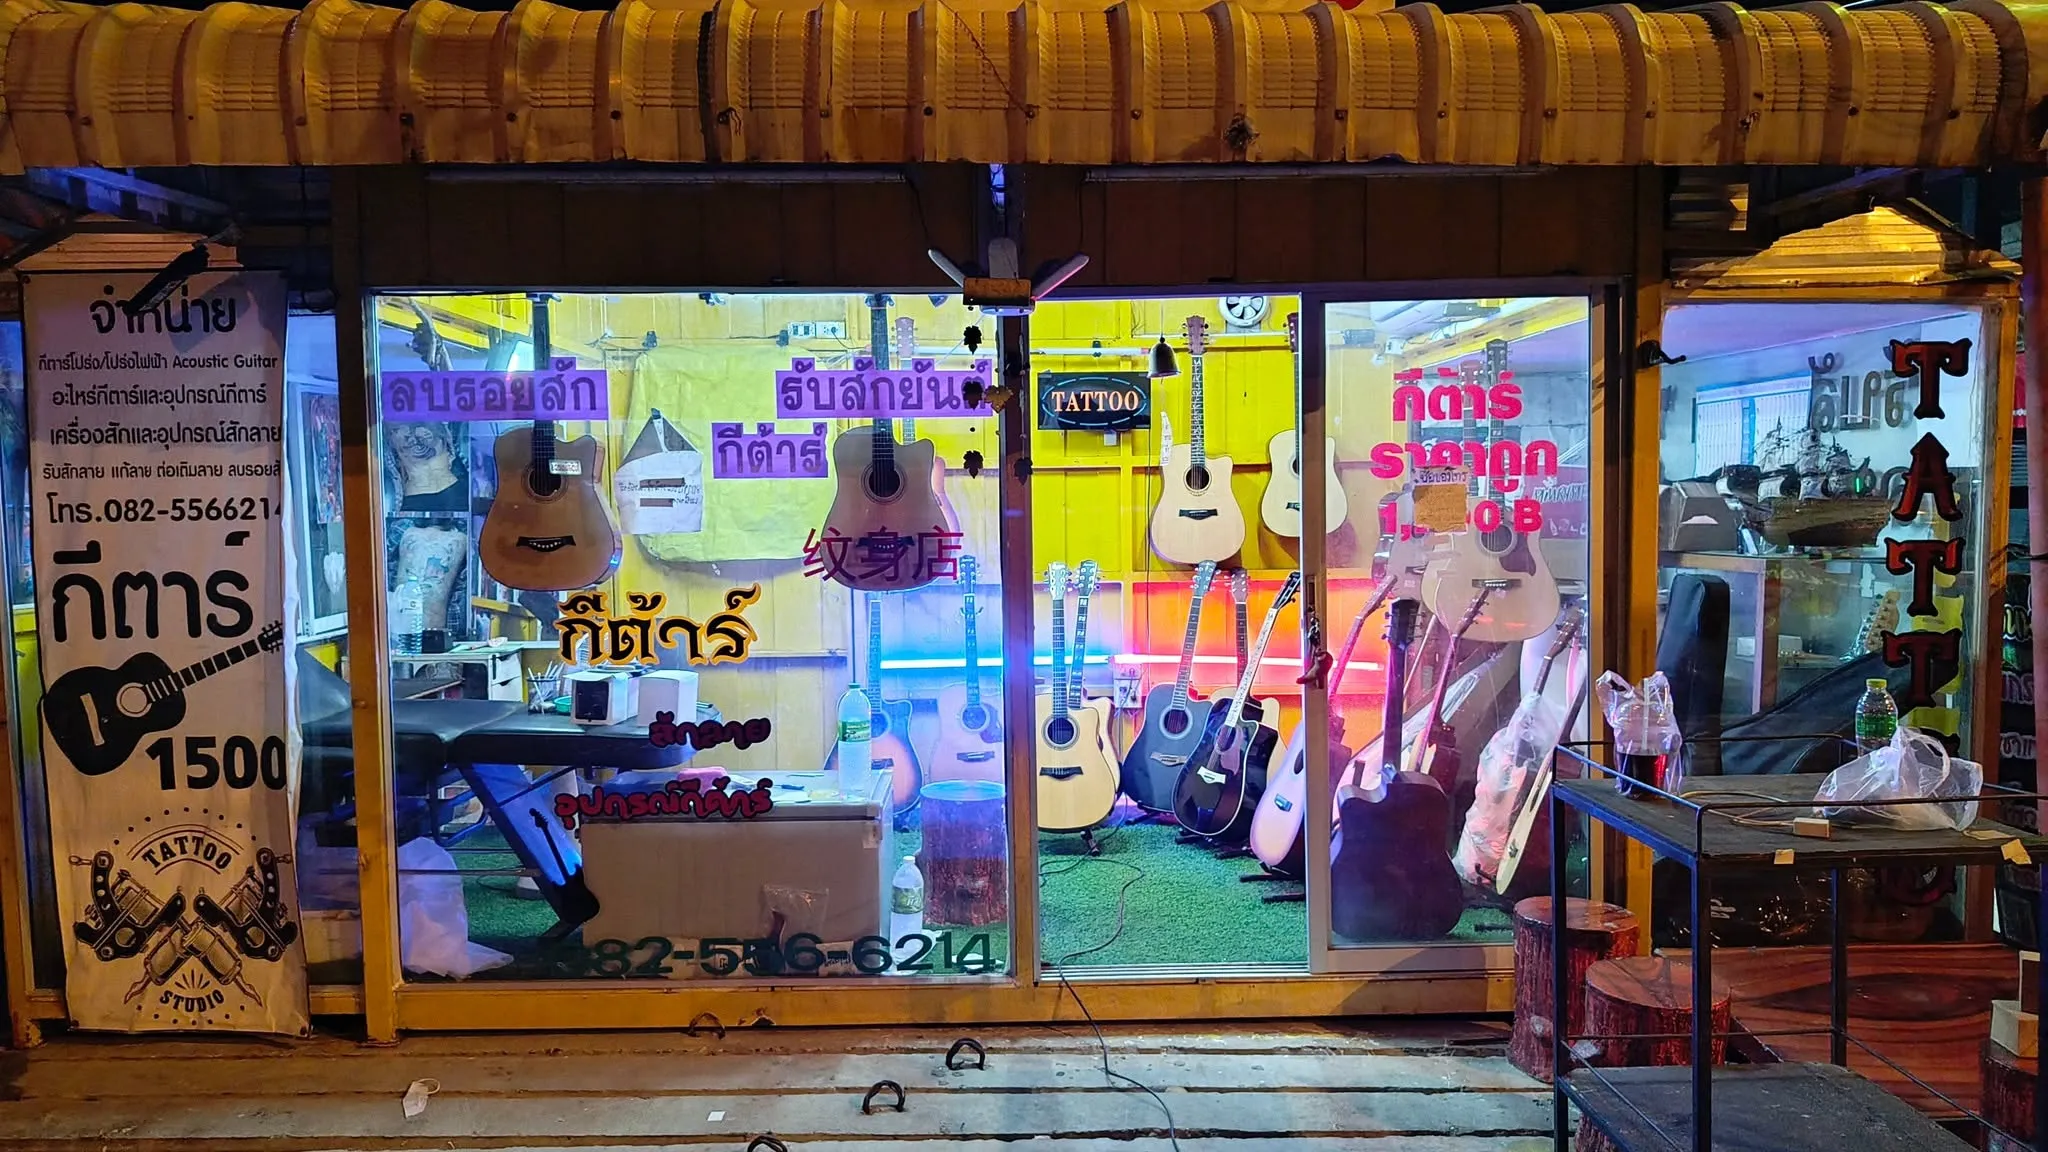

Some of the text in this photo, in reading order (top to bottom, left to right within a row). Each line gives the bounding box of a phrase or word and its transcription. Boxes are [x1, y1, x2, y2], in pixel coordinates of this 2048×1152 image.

[173, 354, 229, 369] Acoustic
[234, 353, 279, 369] Guitar
[389, 358, 597, 412] ลบรอยสัก
[1051, 390, 1139, 412] TATTOO
[1392, 368, 1523, 421] กีต้าร์
[43, 462, 104, 480] รับสักลาย
[112, 461, 152, 479] แก้ลาย
[157, 461, 223, 478] ต่อเติมลาย
[718, 424, 826, 474] กีต้าร์
[1370, 440, 1558, 493] ราคาถูก
[802, 525, 964, 581] 纹身店
[52, 531, 254, 643] กีตาร์
[554, 582, 762, 666] กีต้าร์
[145, 735, 287, 790] 1500
[141, 835, 234, 871] TATTOO
[159, 988, 226, 1013] STUDIO
